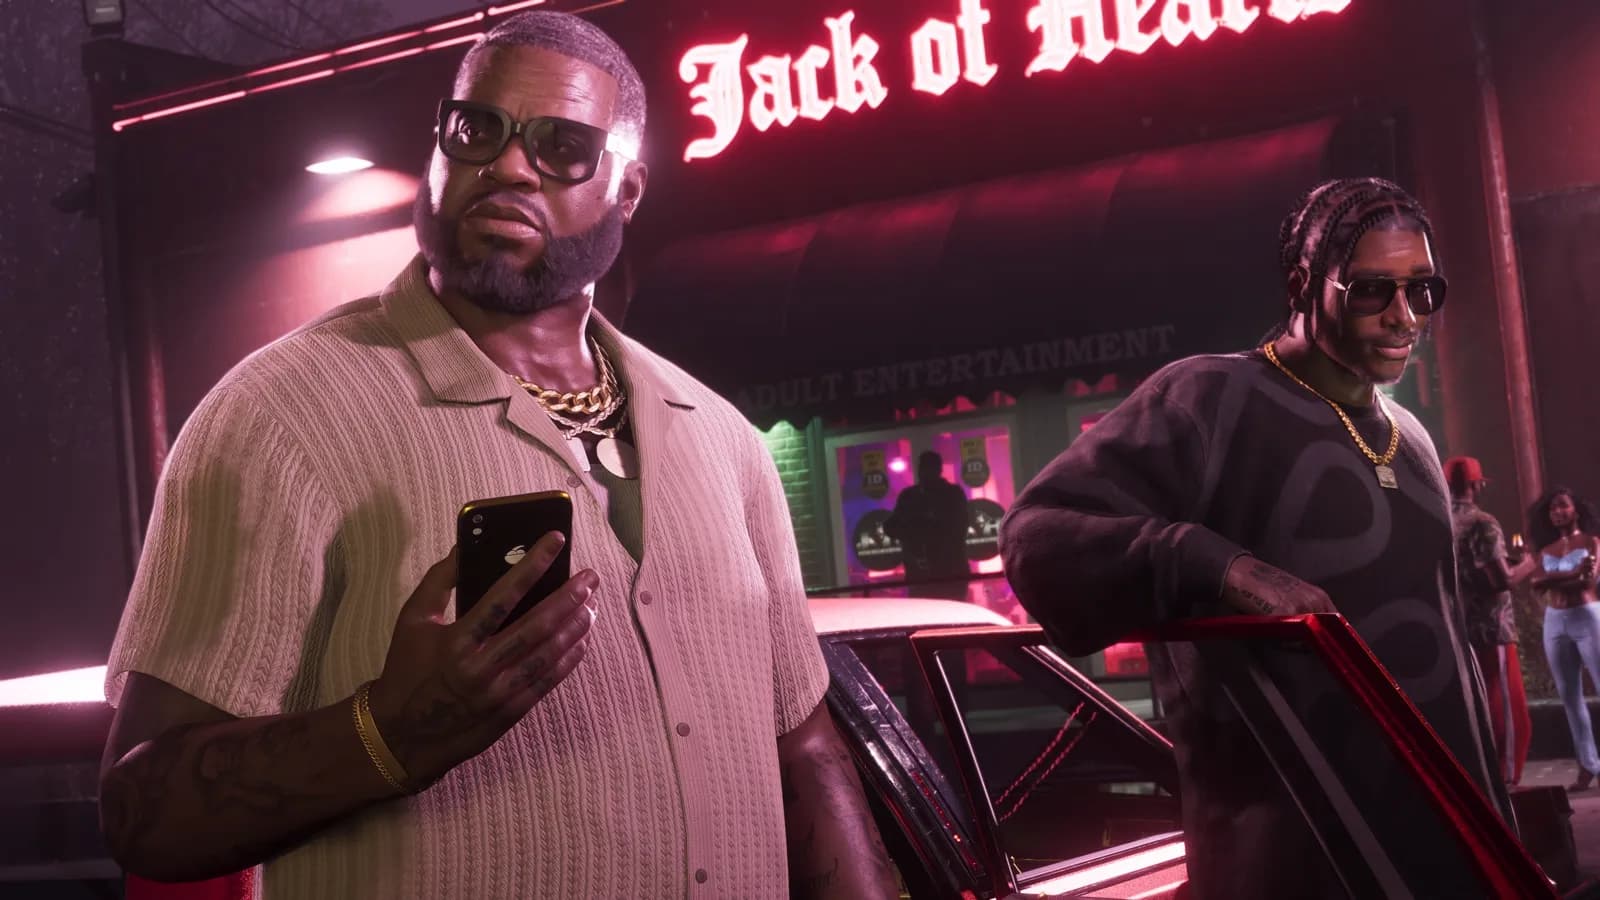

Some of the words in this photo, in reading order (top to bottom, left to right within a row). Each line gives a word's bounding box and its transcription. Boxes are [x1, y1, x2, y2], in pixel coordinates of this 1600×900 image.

[678, 10, 888, 163] Jack
[910, 0, 998, 96] of
[736, 372, 844, 411] ADULT
[852, 323, 1177, 397] ENTERTAINMENT
